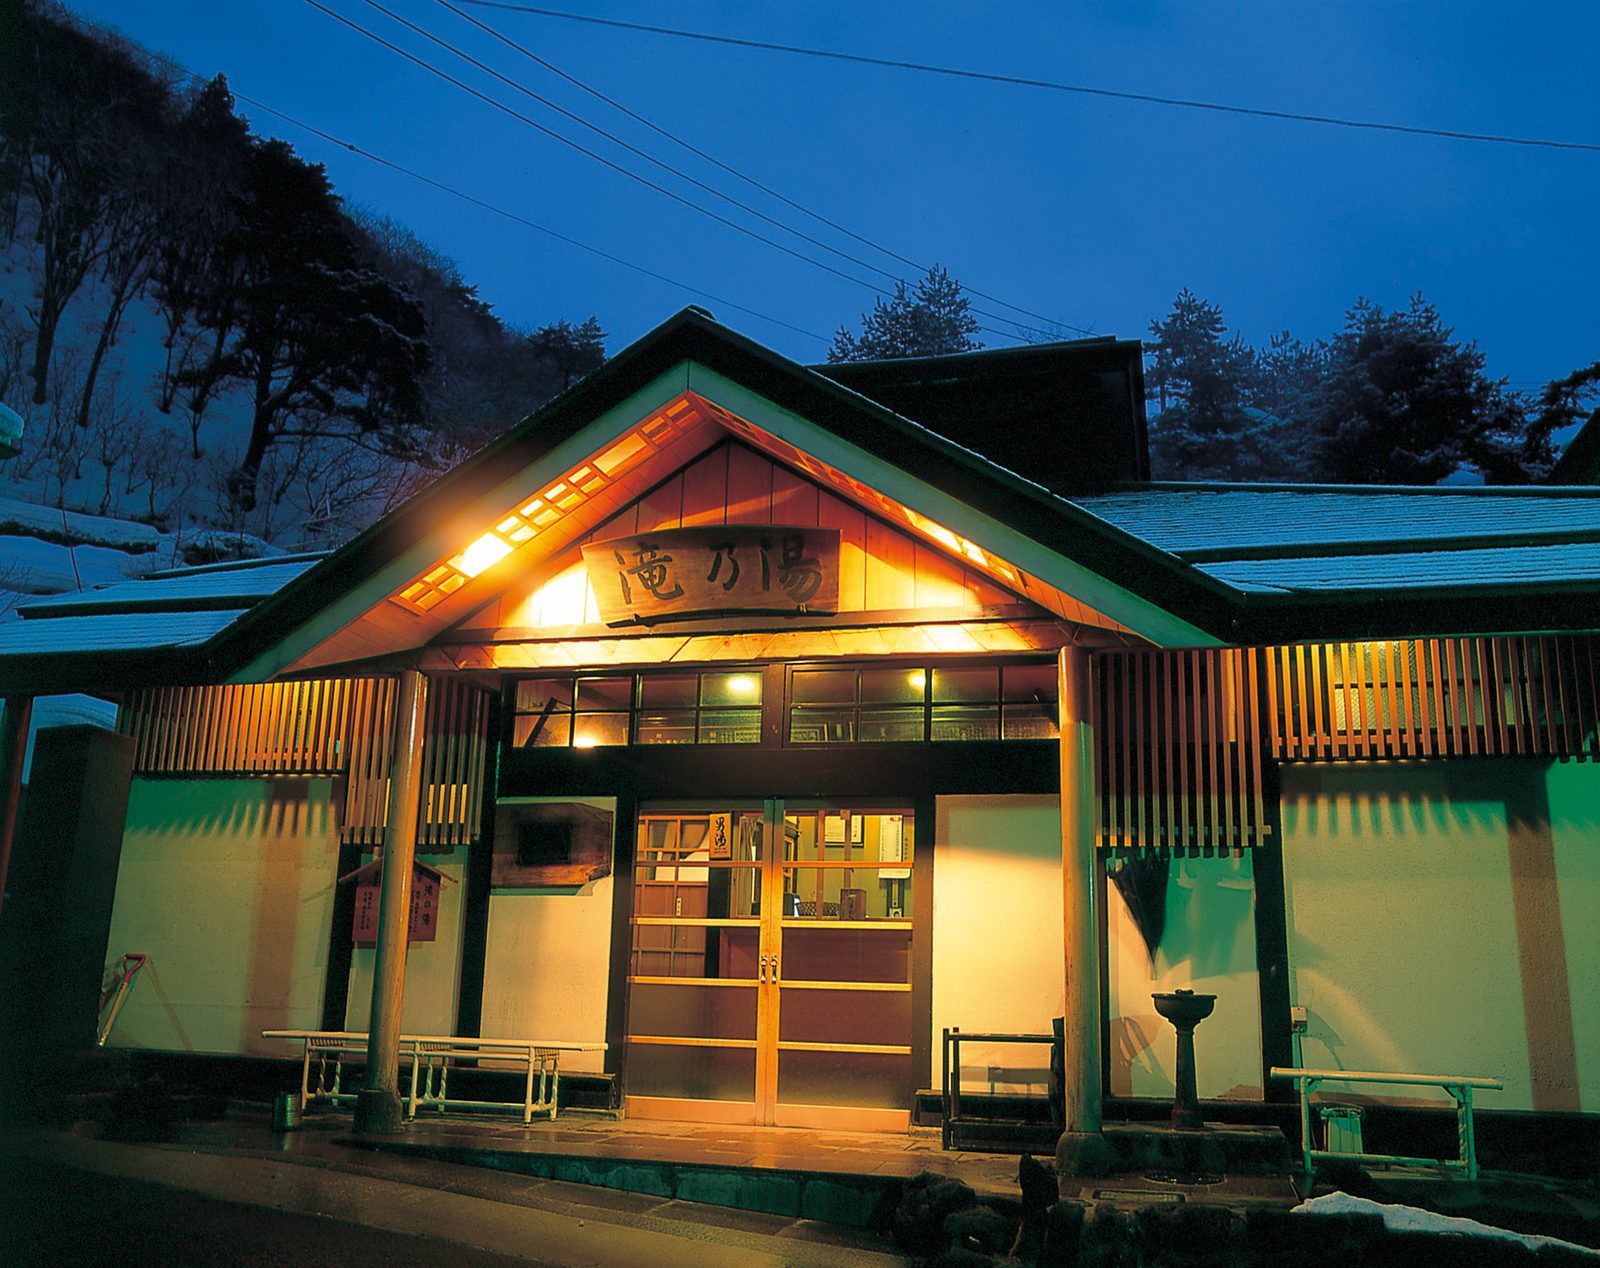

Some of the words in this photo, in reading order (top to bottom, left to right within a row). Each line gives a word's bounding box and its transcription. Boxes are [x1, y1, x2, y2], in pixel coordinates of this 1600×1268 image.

[614, 533, 822, 605] 滝乃湯
[714, 816, 727, 847] 男湯
